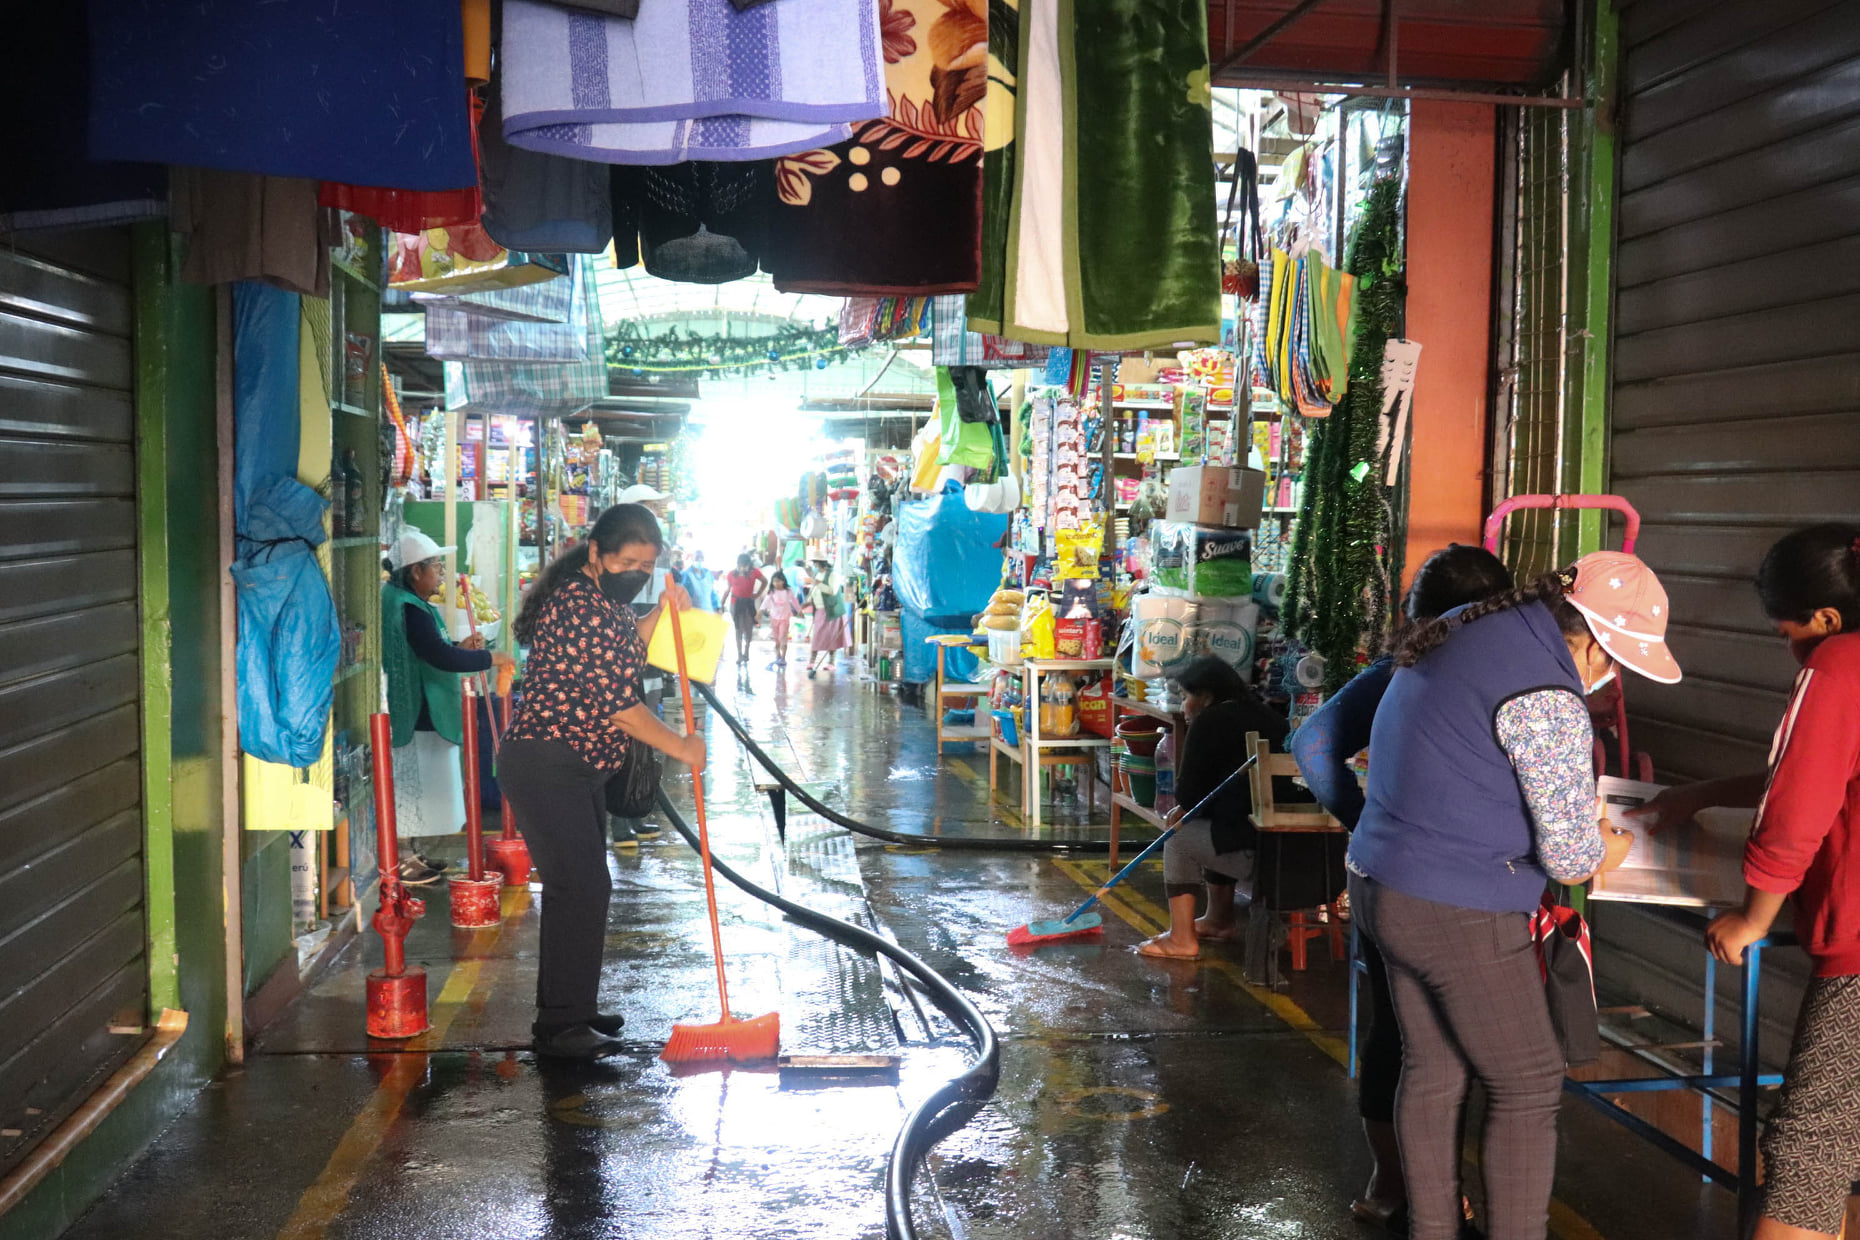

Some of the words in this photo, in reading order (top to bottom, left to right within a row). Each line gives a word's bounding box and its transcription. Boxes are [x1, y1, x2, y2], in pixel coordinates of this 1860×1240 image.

[1201, 540, 1245, 560] Suave
[1148, 632, 1178, 646] Ideal
[1211, 633, 1242, 650] Ideal
